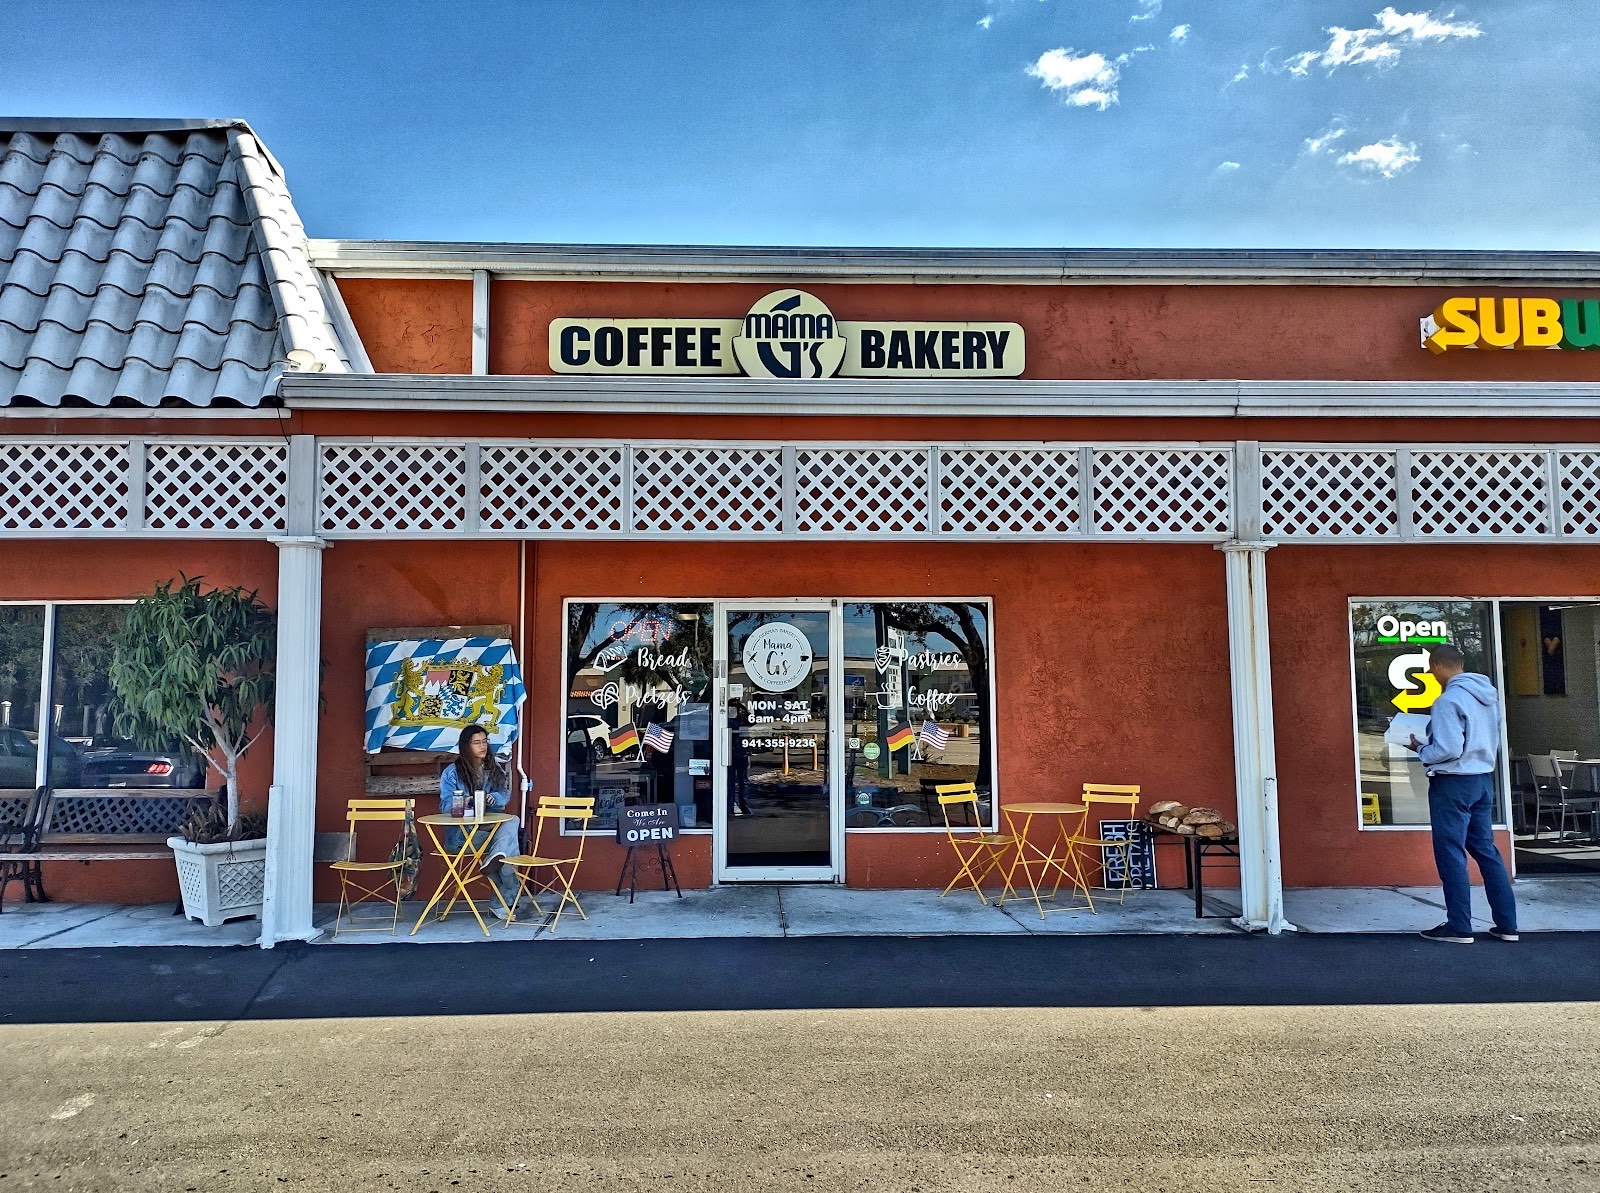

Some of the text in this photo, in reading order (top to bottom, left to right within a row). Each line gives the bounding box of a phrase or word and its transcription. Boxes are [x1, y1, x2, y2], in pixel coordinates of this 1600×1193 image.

[746, 313, 833, 339] MAMA
[559, 325, 722, 368] COFFEE
[860, 329, 1011, 370] BAKERY
[1377, 615, 1447, 642] Open
[763, 638, 794, 650] Mama
[637, 646, 691, 670] Bread
[765, 651, 791, 676] G's
[899, 647, 962, 670] Pastries
[625, 684, 692, 710] Pretzels
[747, 700, 777, 711] MON
[907, 685, 957, 711] Coffee
[747, 714, 774, 723] 6am
[782, 713, 809, 725] 4pm
[741, 738, 817, 748] 941-355-9236
[626, 808, 668, 818] Come In
[626, 826, 674, 842] OPEN
